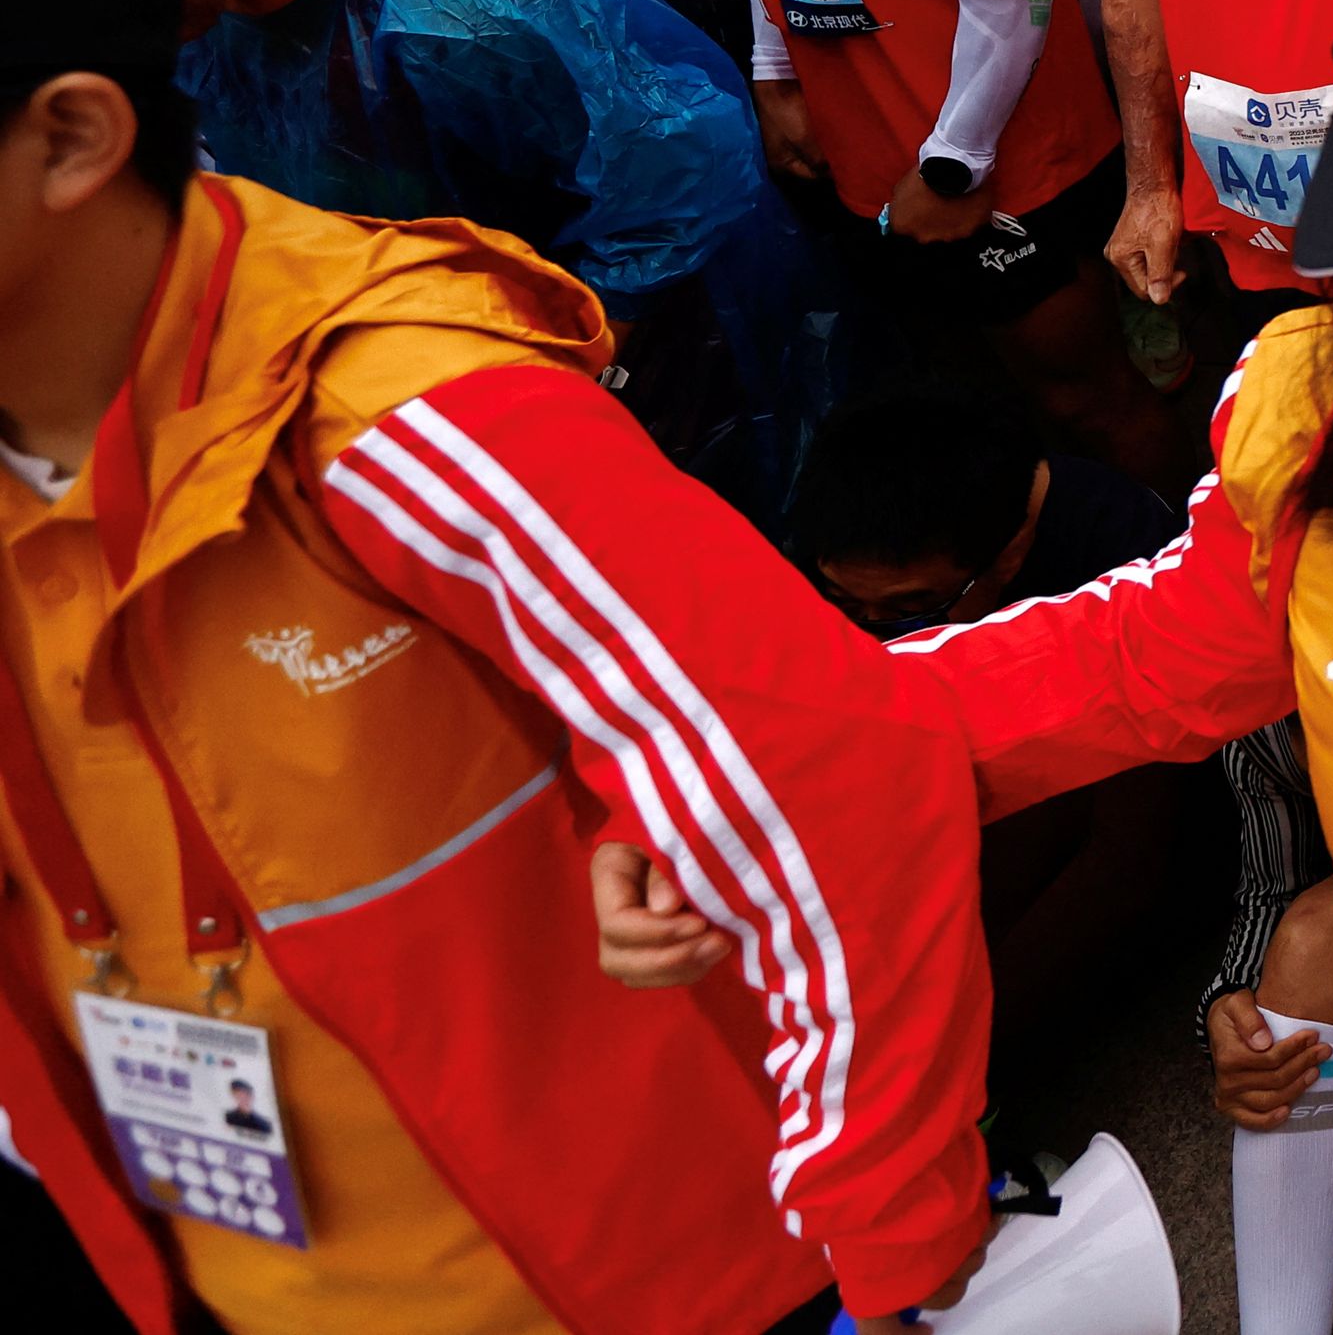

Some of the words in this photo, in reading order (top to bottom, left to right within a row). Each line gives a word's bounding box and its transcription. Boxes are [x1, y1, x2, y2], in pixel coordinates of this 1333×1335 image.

[810, 13, 870, 29] 北京现代
[1275, 98, 1323, 121] 贝壳
